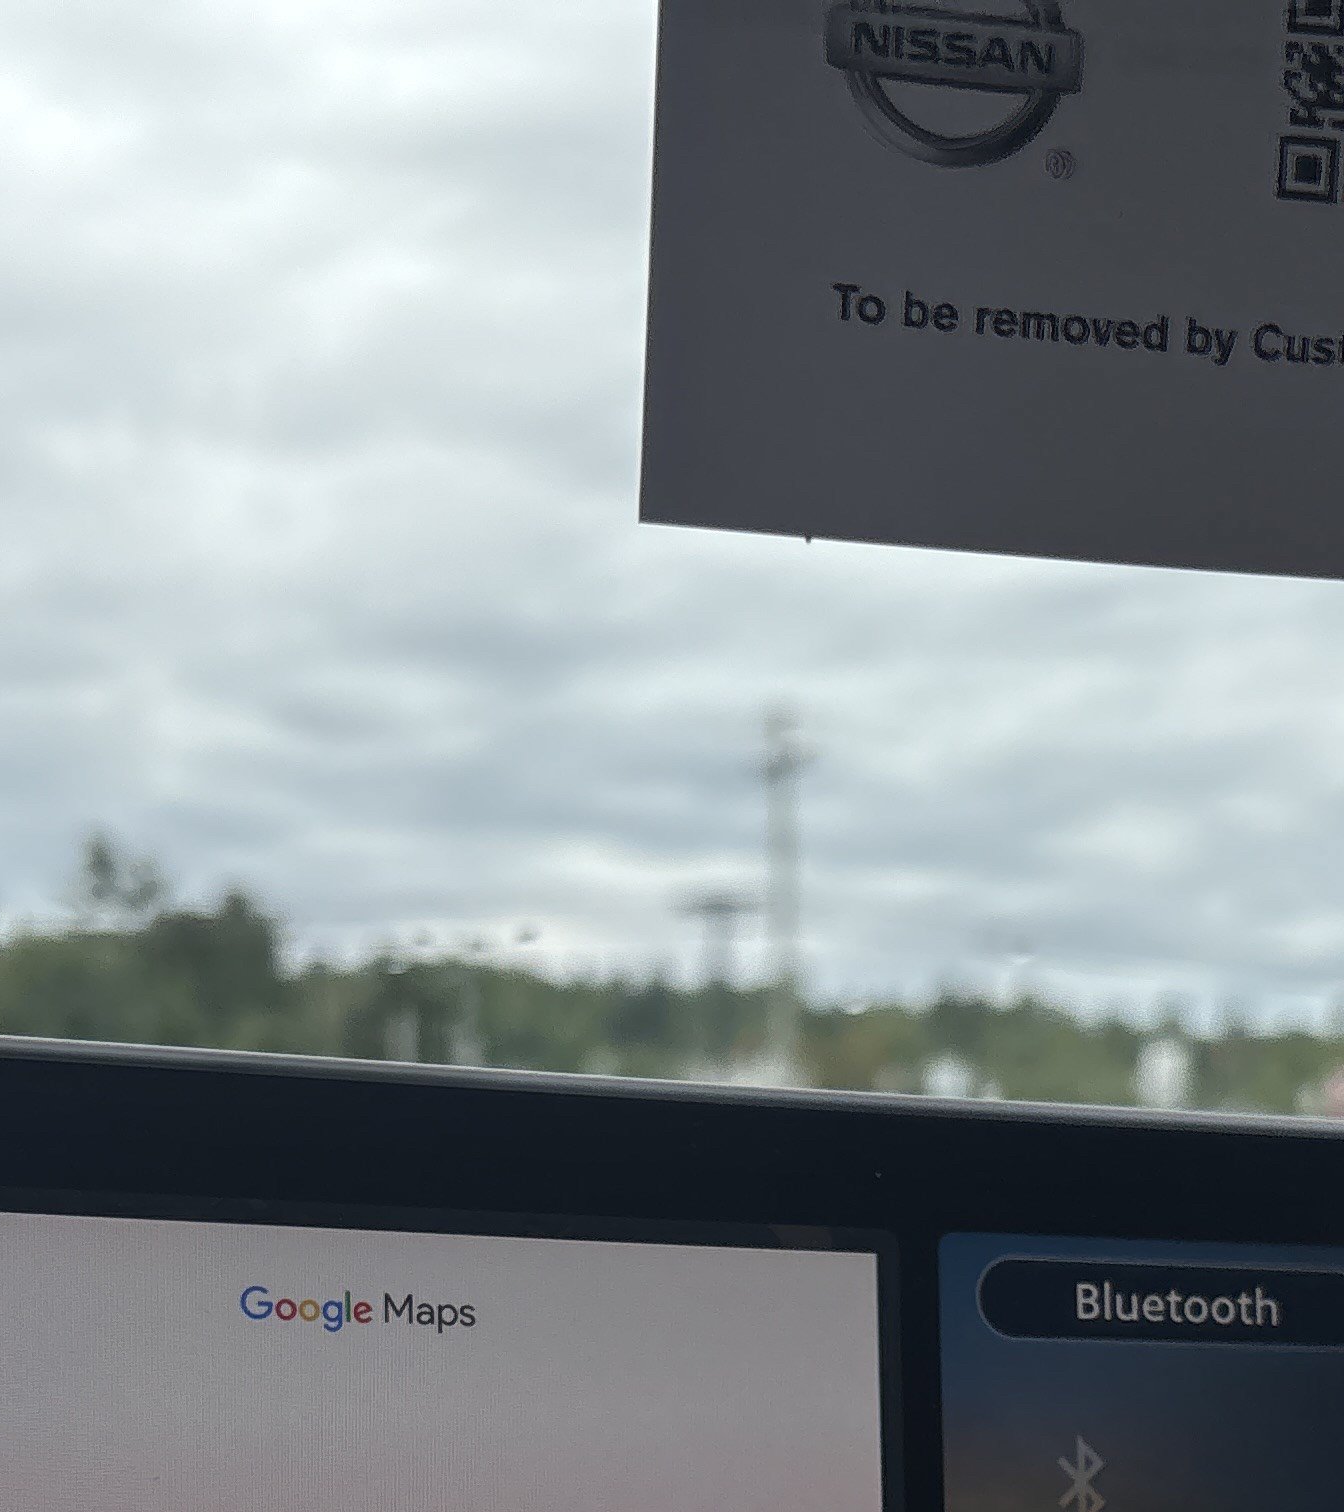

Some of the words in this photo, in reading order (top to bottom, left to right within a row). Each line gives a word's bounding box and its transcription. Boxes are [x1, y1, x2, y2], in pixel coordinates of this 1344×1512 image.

[855, 20, 1055, 75] NISSAN
[833, 283, 886, 325] To
[903, 290, 959, 333] be
[975, 303, 1169, 352] removed
[1187, 317, 1238, 366] by
[240, 1286, 372, 1333] Google
[384, 1293, 476, 1333] Maps
[1076, 1282, 1278, 1326] Bluetooth
